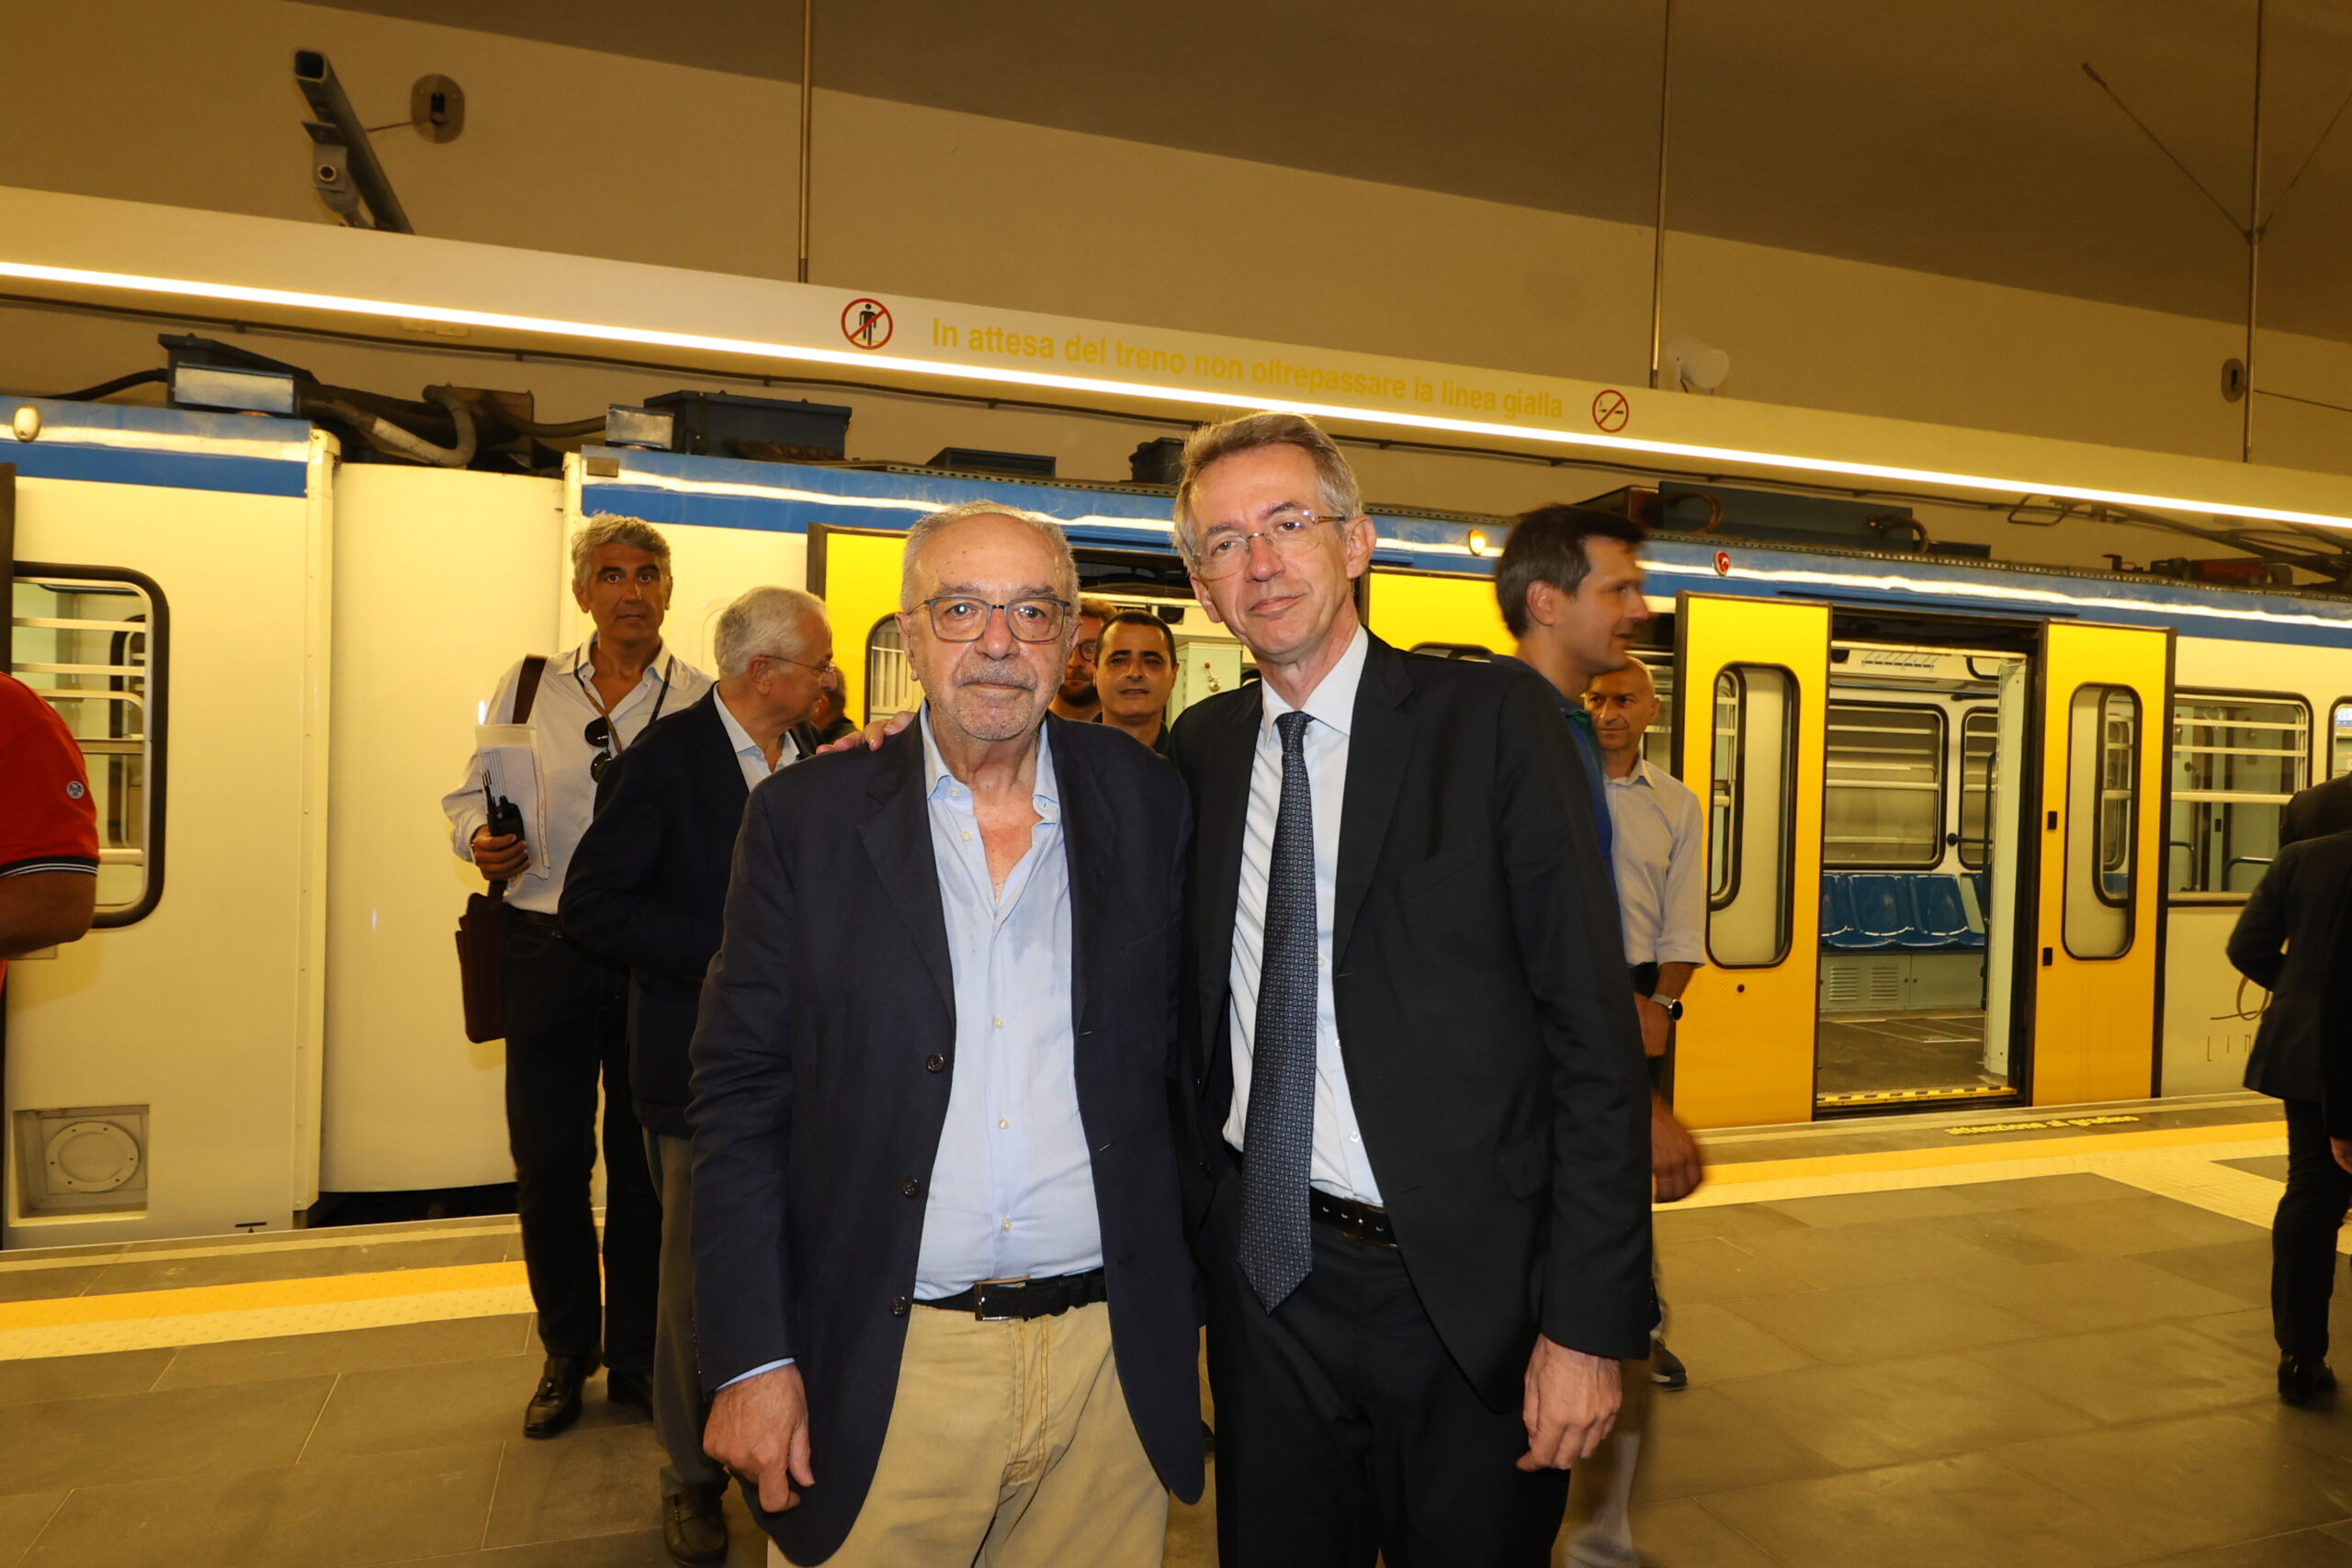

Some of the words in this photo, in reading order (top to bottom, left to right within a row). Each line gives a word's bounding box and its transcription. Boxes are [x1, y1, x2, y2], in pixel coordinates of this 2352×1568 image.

[933, 317, 958, 348] In
[967, 325, 1056, 360] attesa
[1064, 333, 1106, 366] del
[1115, 341, 1186, 376] treno
[1194, 355, 1243, 381] non
[1251, 358, 1407, 400] oltrepassare
[1414, 376, 1433, 403] la
[1442, 379, 1497, 412] linea
[1503, 390, 1563, 421] gialla
